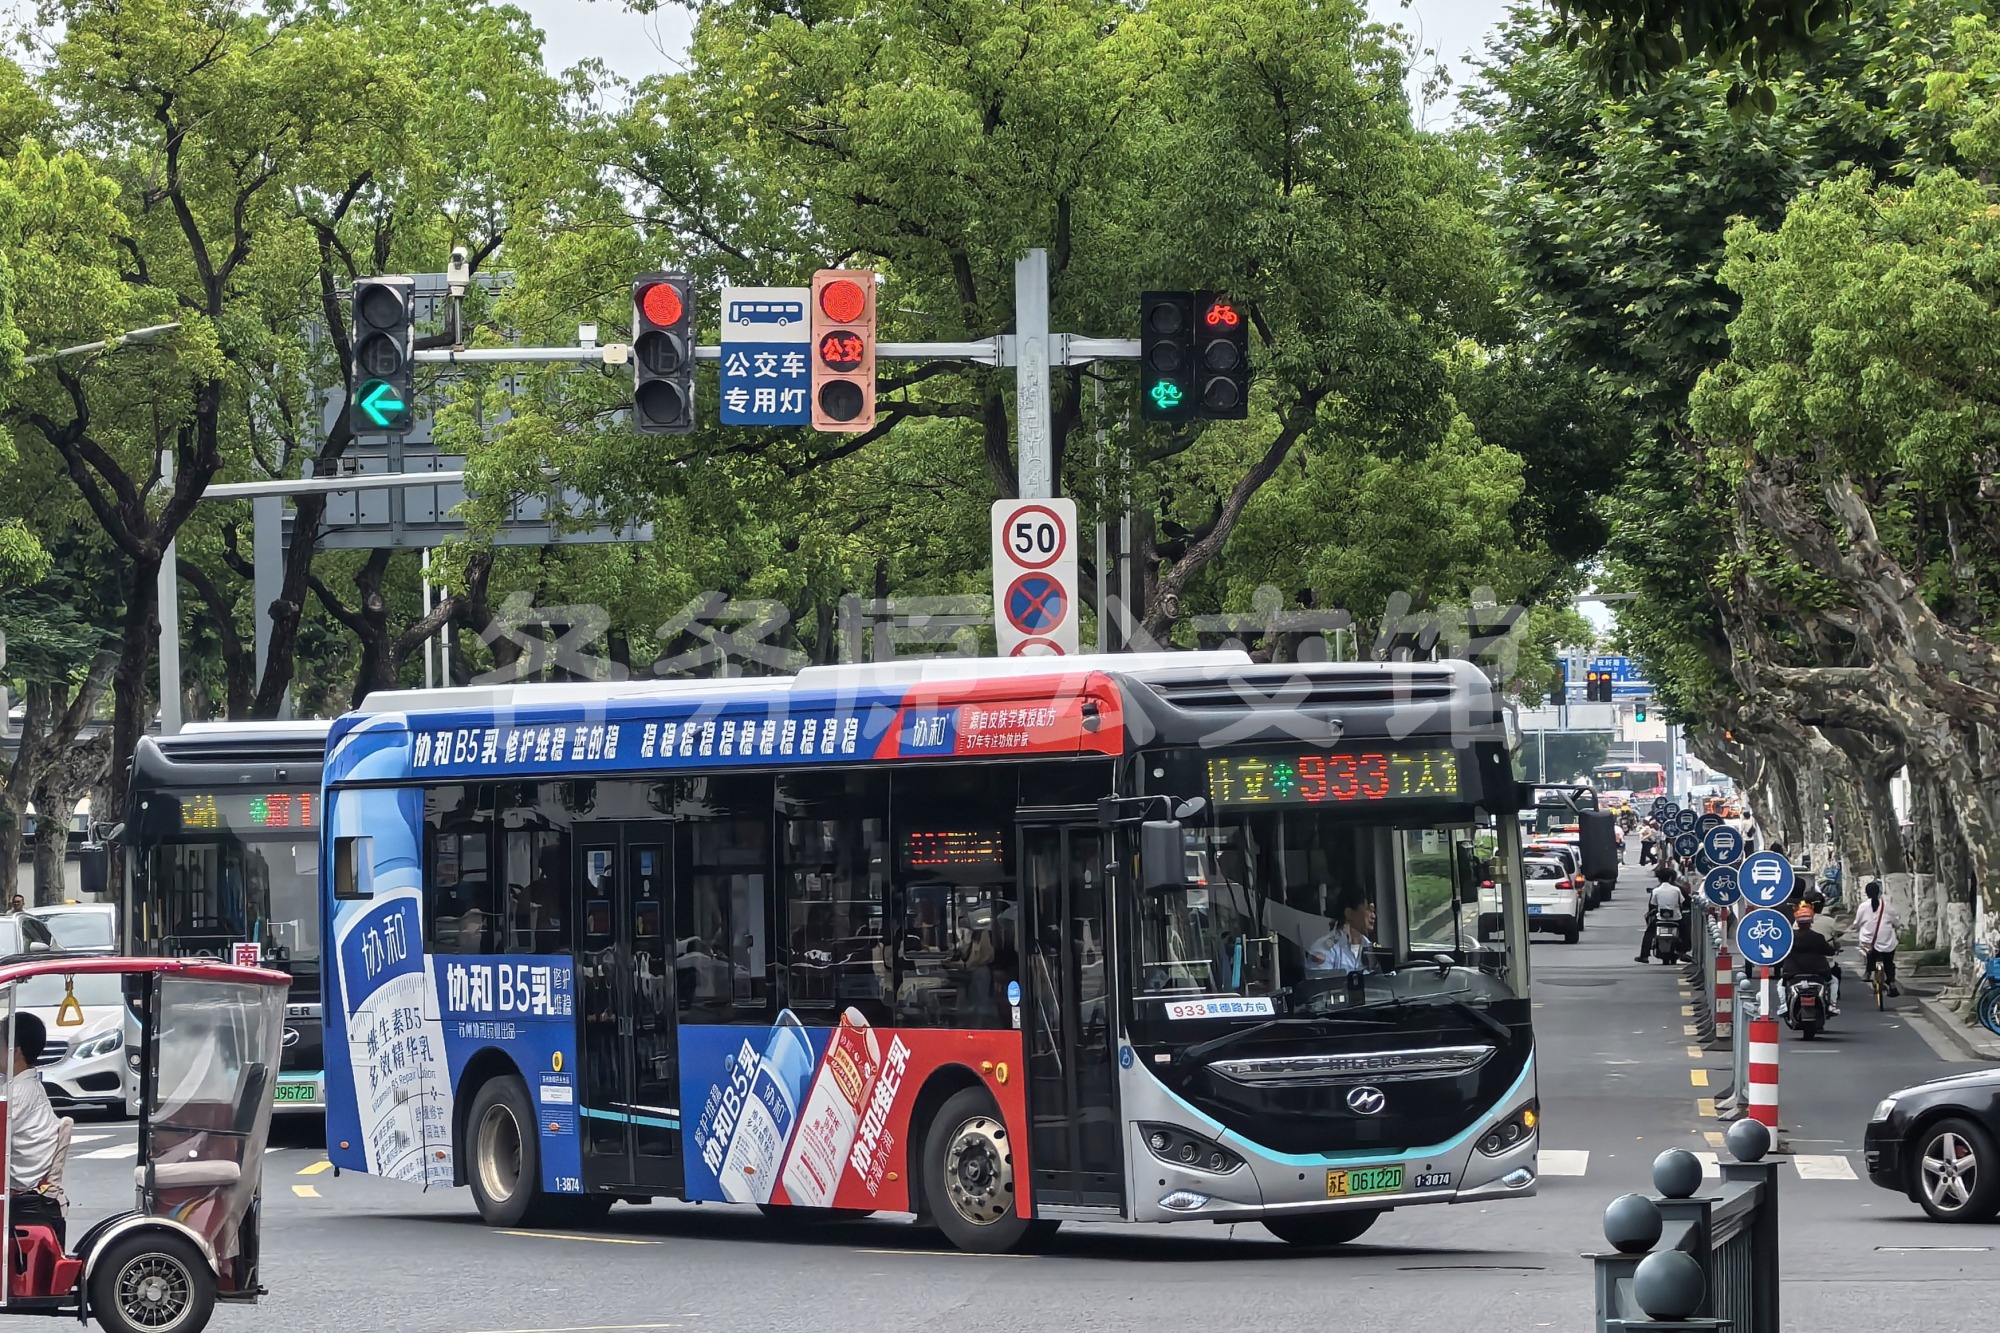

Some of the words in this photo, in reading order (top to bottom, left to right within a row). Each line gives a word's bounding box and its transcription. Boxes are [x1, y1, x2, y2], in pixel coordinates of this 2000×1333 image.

[724, 351, 806, 379] 公交车
[822, 336, 864, 362] 公交
[724, 386, 806, 414] 专用灯
[1015, 523, 1055, 554] 50
[912, 716, 947, 747] 协和
[969, 707, 1056, 730] 源自皮肤学教授配方
[413, 728, 500, 768] 协和B5乳
[503, 726, 566, 763] 修护维稳
[571, 724, 621, 760] 蓝的稳
[966, 732, 1029, 749] 37年专注功效护肤
[1298, 754, 1390, 801] 933
[235, 943, 259, 967] 南
[361, 908, 407, 981] 协和
[447, 963, 555, 1015] 协和B5乳
[367, 1006, 422, 1060] 维生素B5
[369, 1034, 435, 1099] 多效精华乳
[702, 1036, 760, 1177] 协和B5乳
[763, 1082, 787, 1124] 协和
[849, 1032, 912, 1182] 协和维E乳
